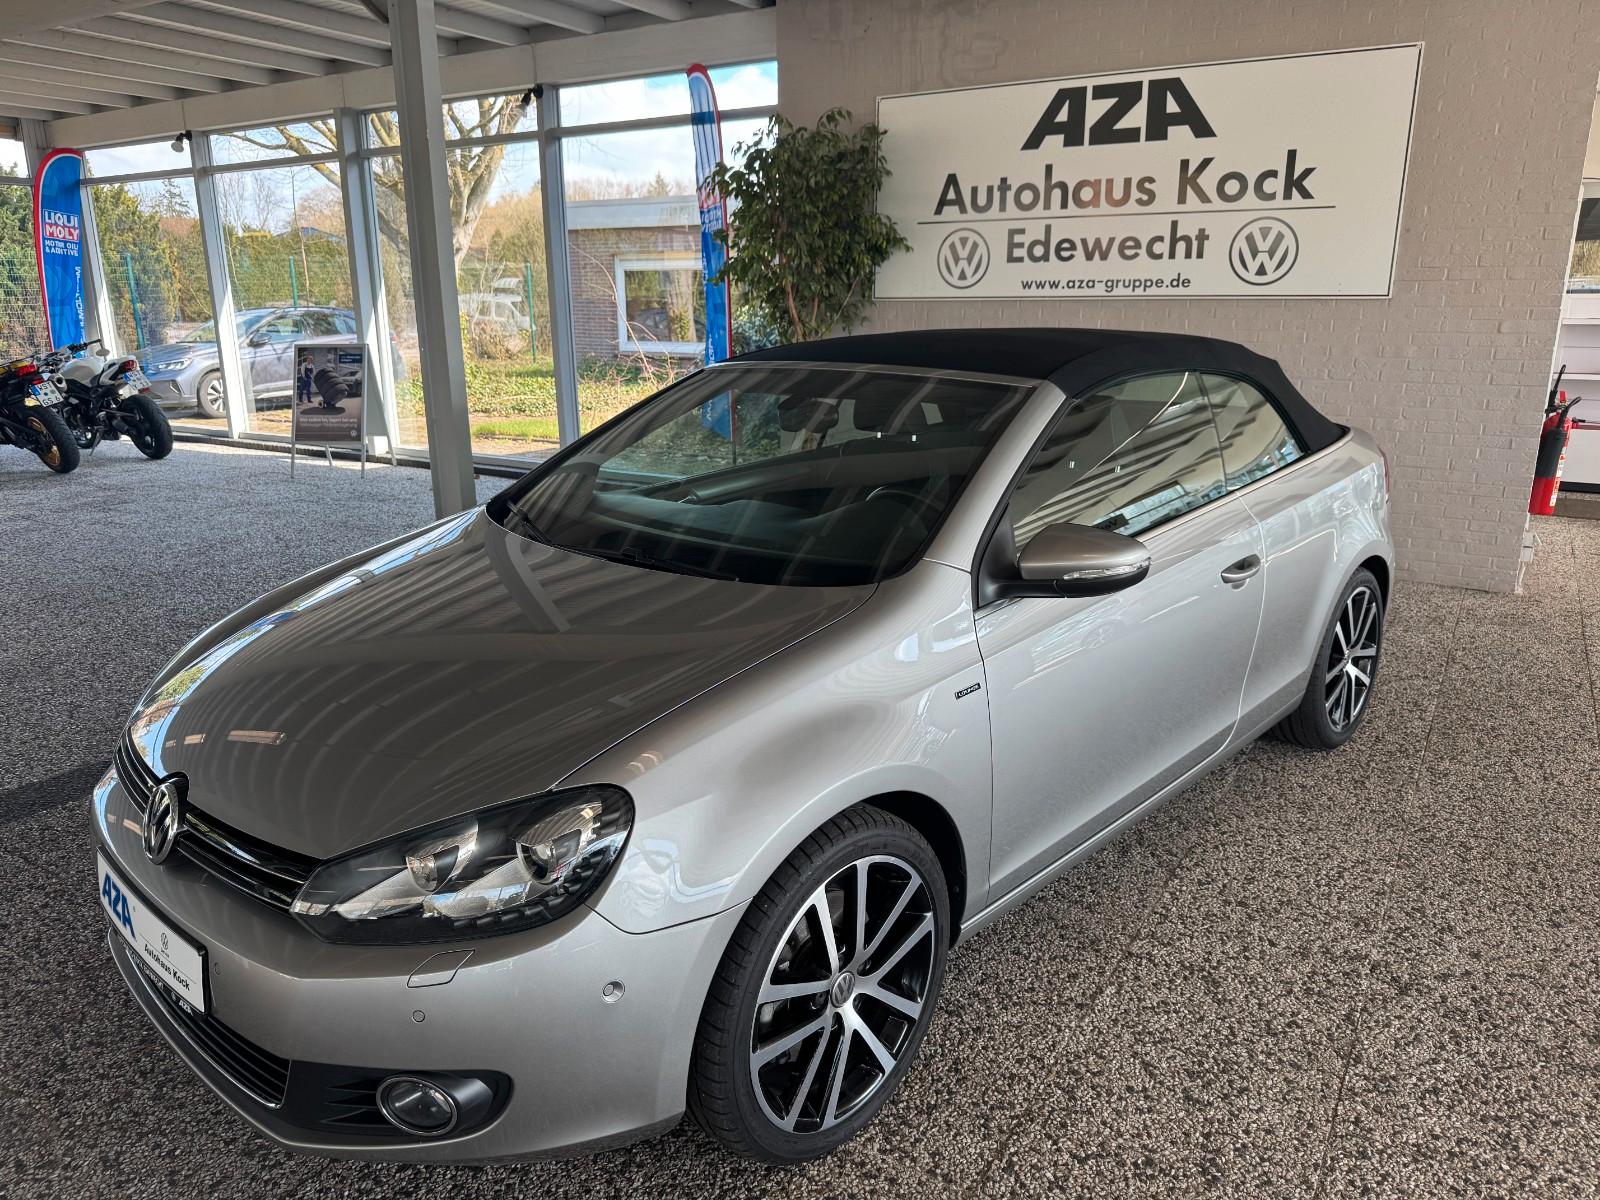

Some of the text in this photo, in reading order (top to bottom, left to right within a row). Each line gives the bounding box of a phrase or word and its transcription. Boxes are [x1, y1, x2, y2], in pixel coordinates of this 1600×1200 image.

[1020, 77, 1217, 150] AZA
[933, 148, 1318, 217] Autohaus Kock
[45, 211, 78, 227] LIQUI
[45, 224, 79, 240] MOLY
[1006, 219, 1210, 264] Edewecht
[1021, 273, 1191, 293] www.aza-gruppe.de
[102, 872, 136, 941] AZA
[144, 943, 173, 976] Autohaus
[172, 968, 191, 991] Kock
